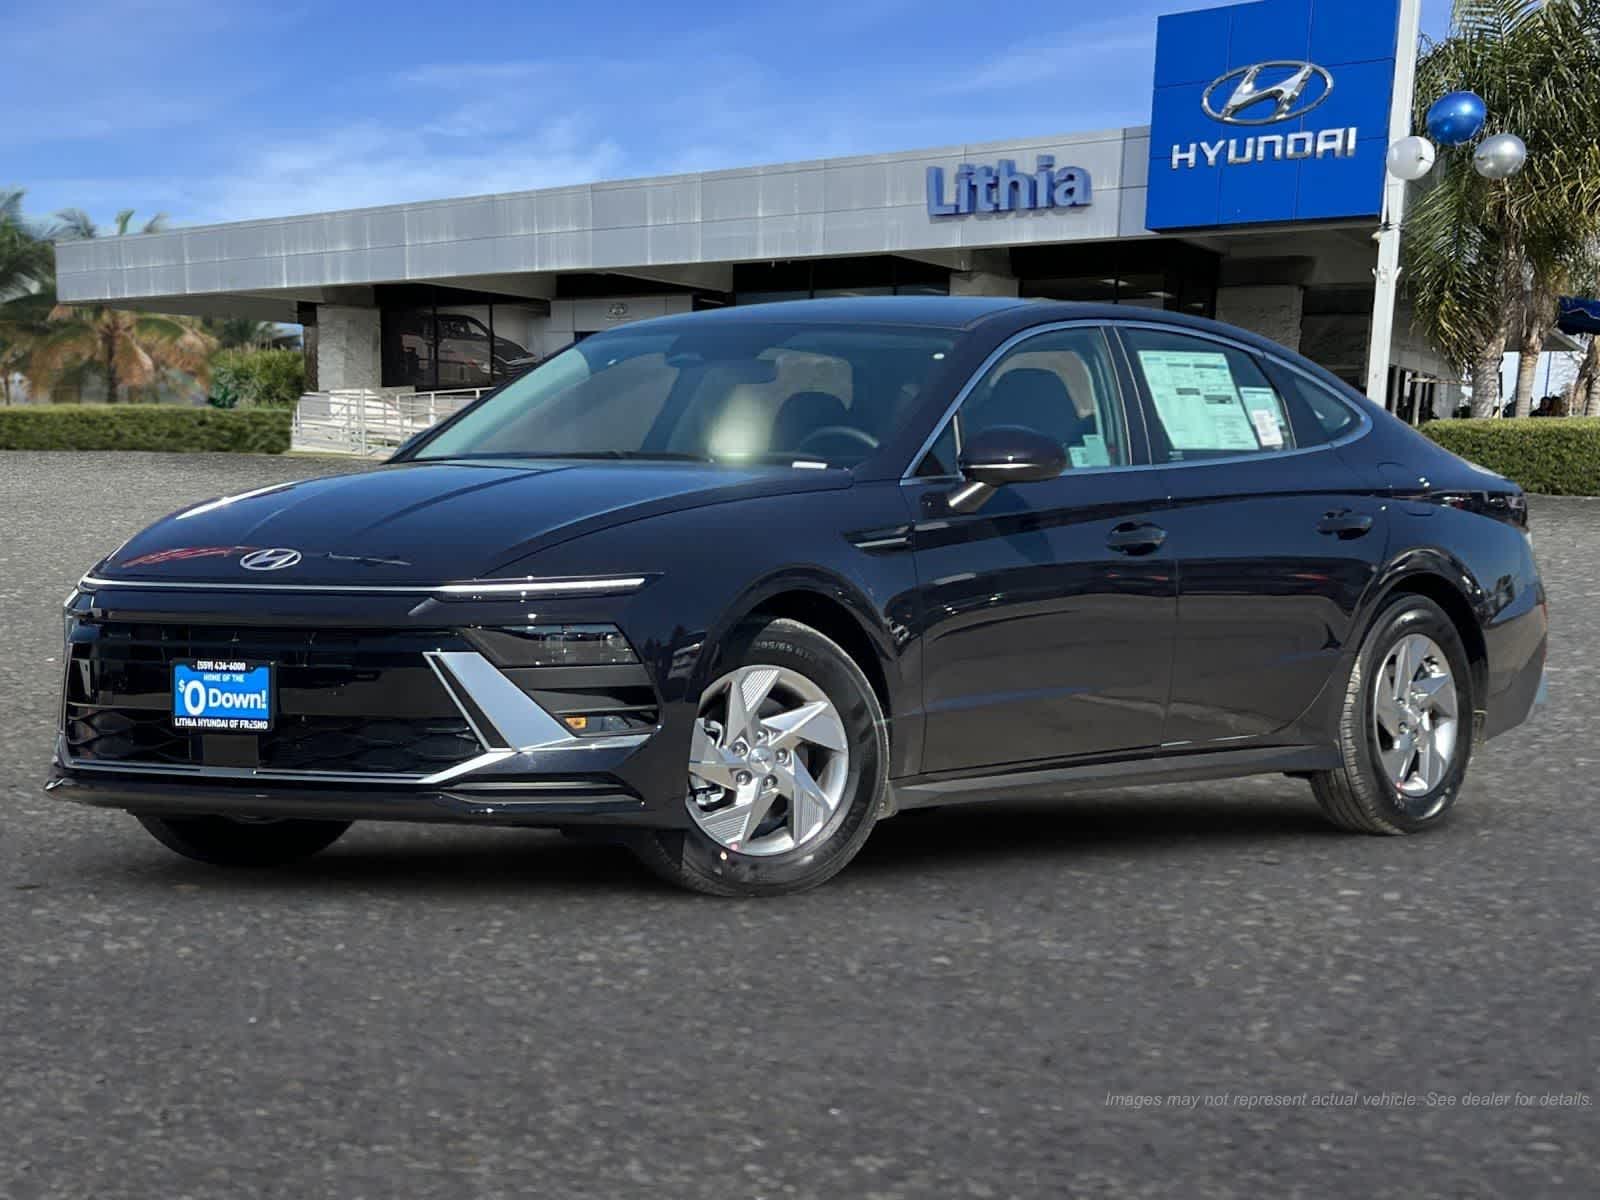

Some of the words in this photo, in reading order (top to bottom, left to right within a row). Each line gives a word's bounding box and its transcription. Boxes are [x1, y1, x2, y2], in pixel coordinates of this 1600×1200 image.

[1170, 126, 1357, 169] HYUNDAI
[925, 155, 1092, 219] Lithia
[203, 673, 221, 682] HOME
[222, 674, 230, 682] OF
[231, 674, 245, 683] THE
[208, 688, 267, 710] Down!
[175, 718, 197, 727] LITHIA
[198, 719, 228, 728] HYUNDAI
[229, 719, 239, 728] OF
